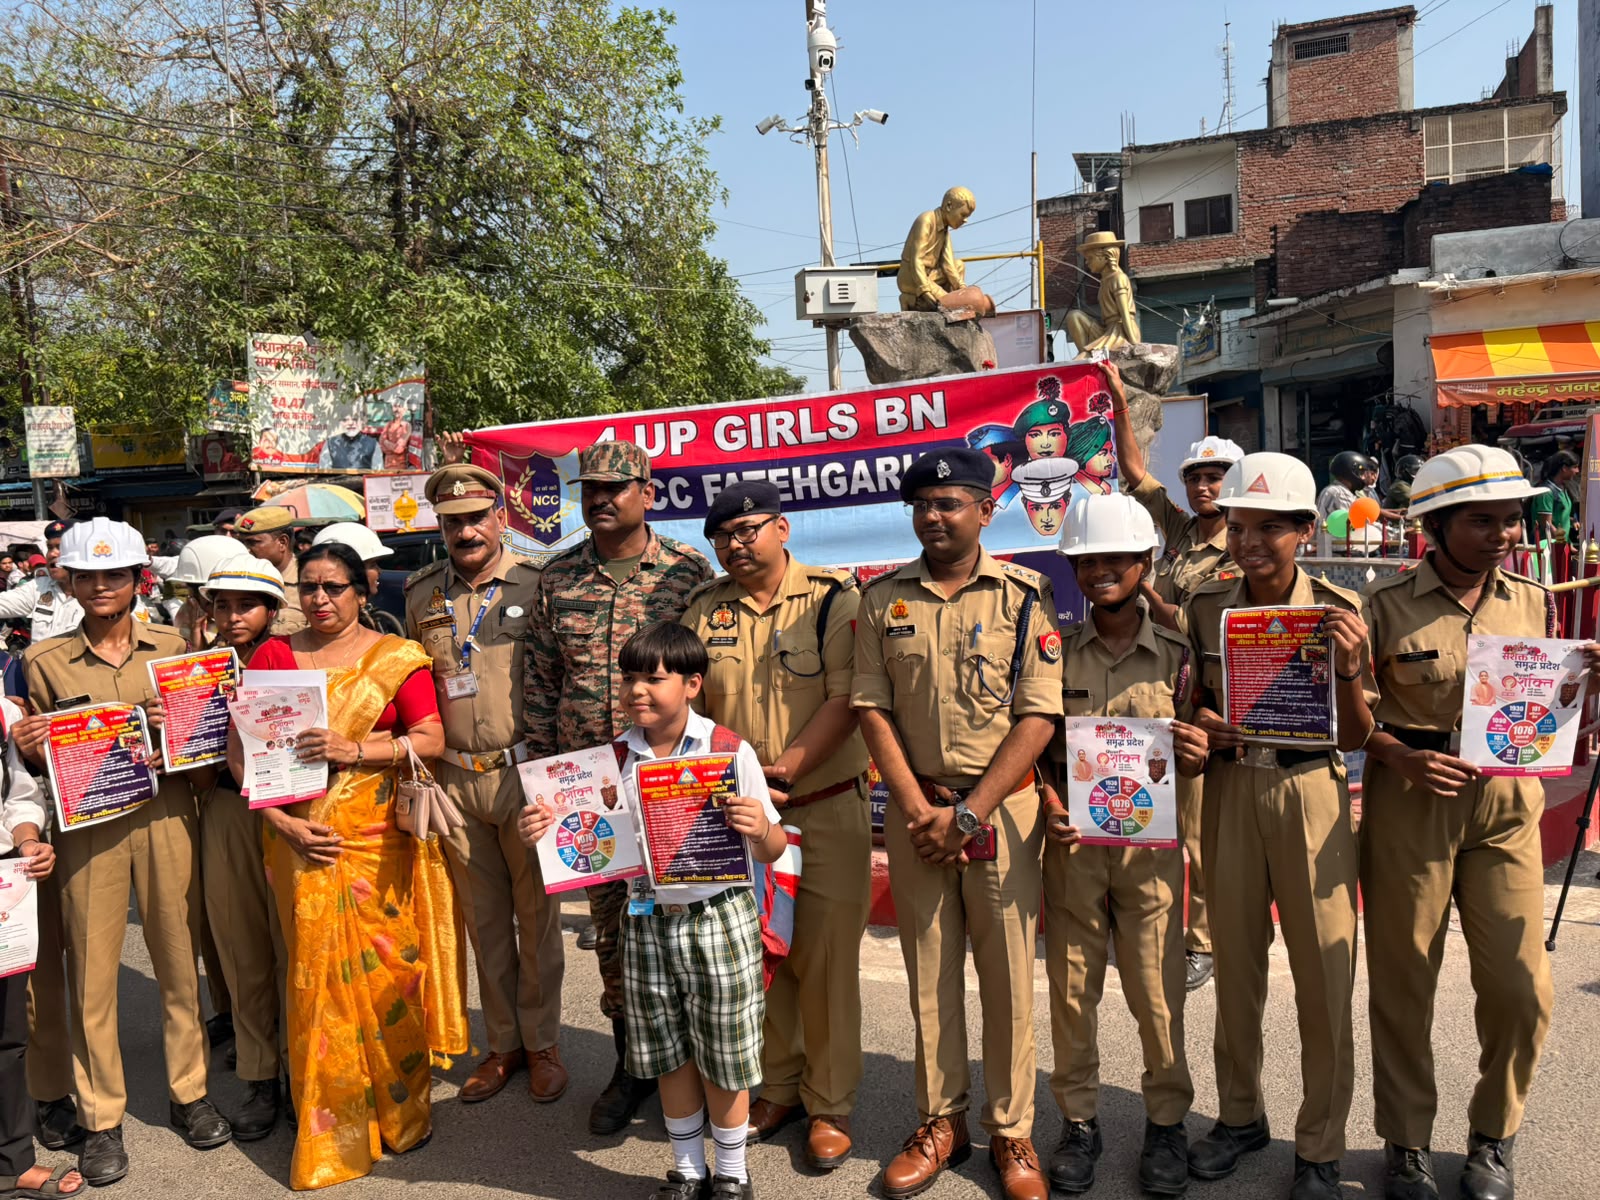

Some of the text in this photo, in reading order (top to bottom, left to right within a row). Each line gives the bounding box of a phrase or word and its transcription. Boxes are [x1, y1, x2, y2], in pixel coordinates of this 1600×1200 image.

[1496, 381, 1550, 396] महेन्द्र
[634, 419, 698, 458] UP
[712, 402, 860, 452] GIRLS
[874, 390, 948, 436] BN
[651, 452, 928, 510] CC FTEHGAR
[533, 495, 560, 506] NCC
[1529, 652, 1548, 662] नारी
[1514, 660, 1560, 671] समृद्ध प्रदेश
[1516, 674, 1554, 693] शक्ति
[1513, 726, 1533, 735] 1076
[1106, 738, 1144, 749] समृद्ध प्रदेश
[577, 771, 592, 780] प्रदेश
[1111, 799, 1130, 808] 1076
[576, 834, 594, 844] 1076
